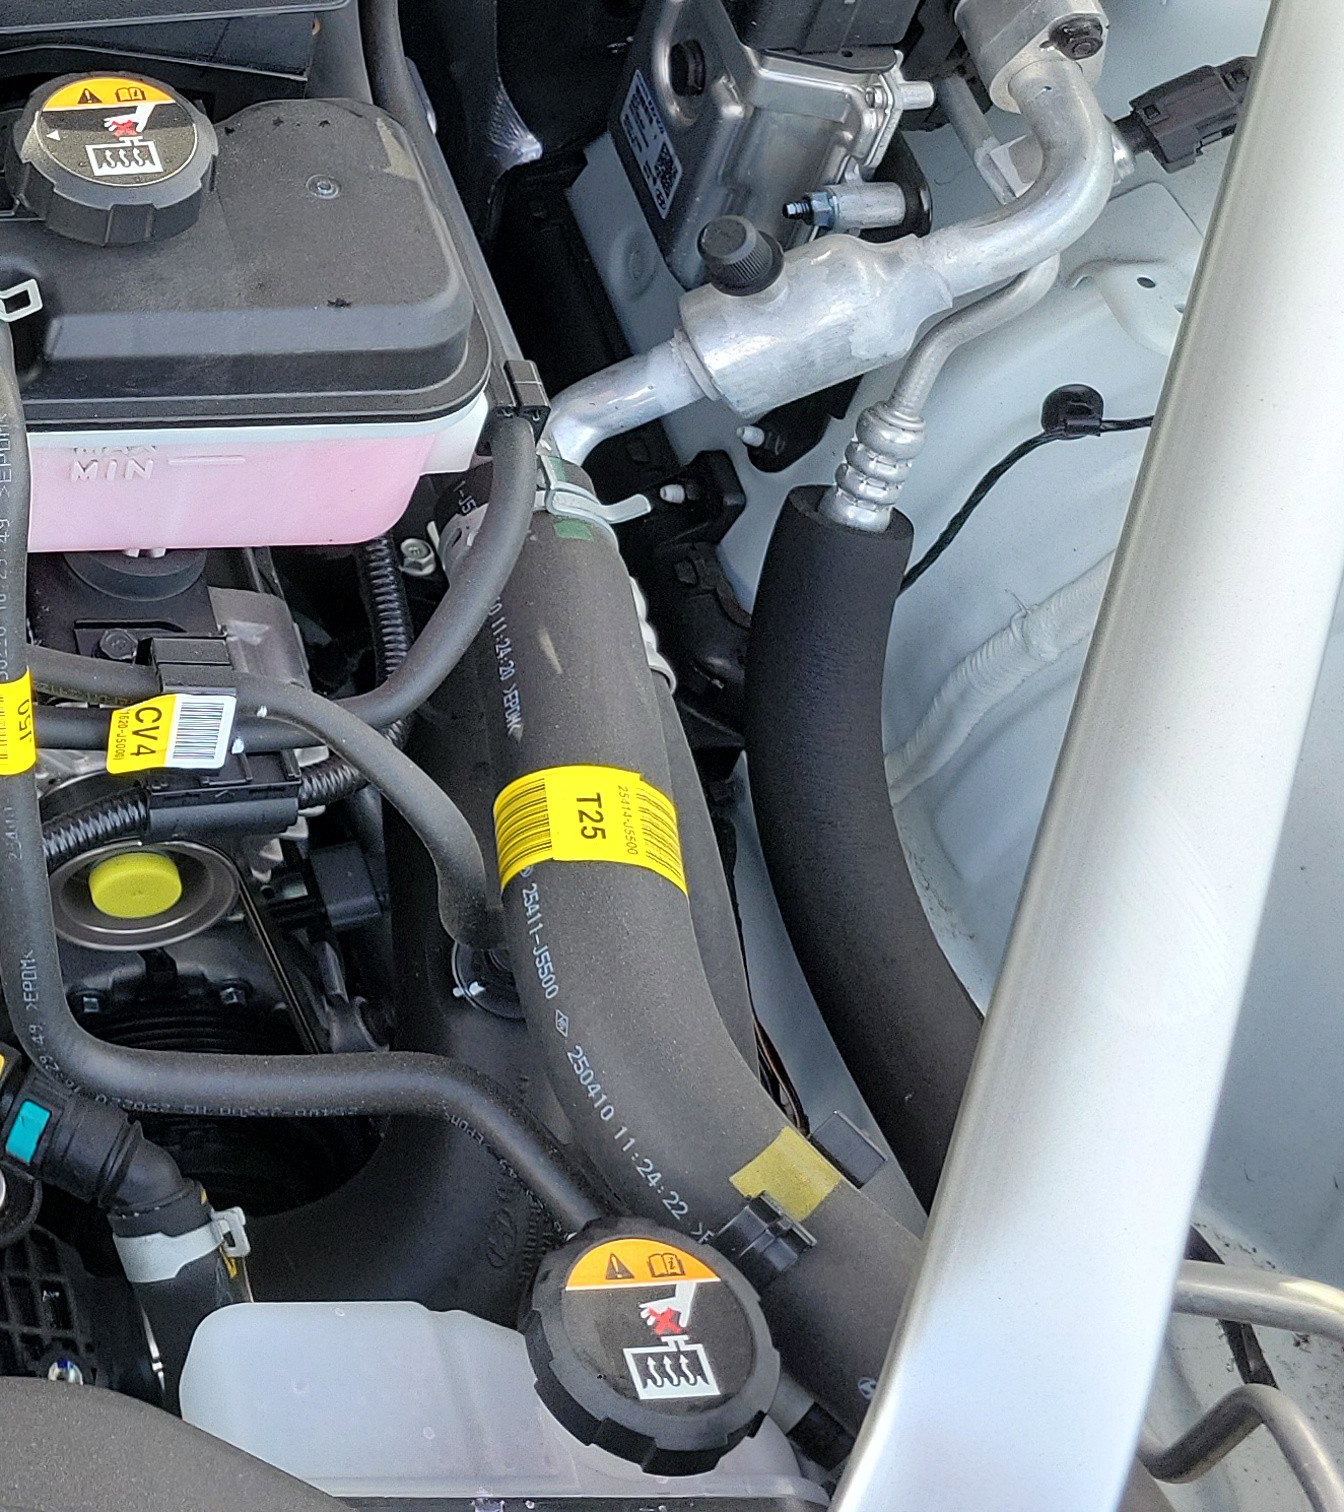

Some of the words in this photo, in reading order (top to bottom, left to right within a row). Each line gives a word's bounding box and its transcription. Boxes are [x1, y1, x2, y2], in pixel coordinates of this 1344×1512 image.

[70, 459, 155, 484] MIN
[130, 706, 163, 757] CV4
[576, 792, 607, 840] T25
[20, 949, 39, 1011] >EPDM<
[522, 883, 559, 1000] 25411-J5500
[567, 1045, 615, 1122] 250410
[614, 1126, 689, 1221] 11:24:22
